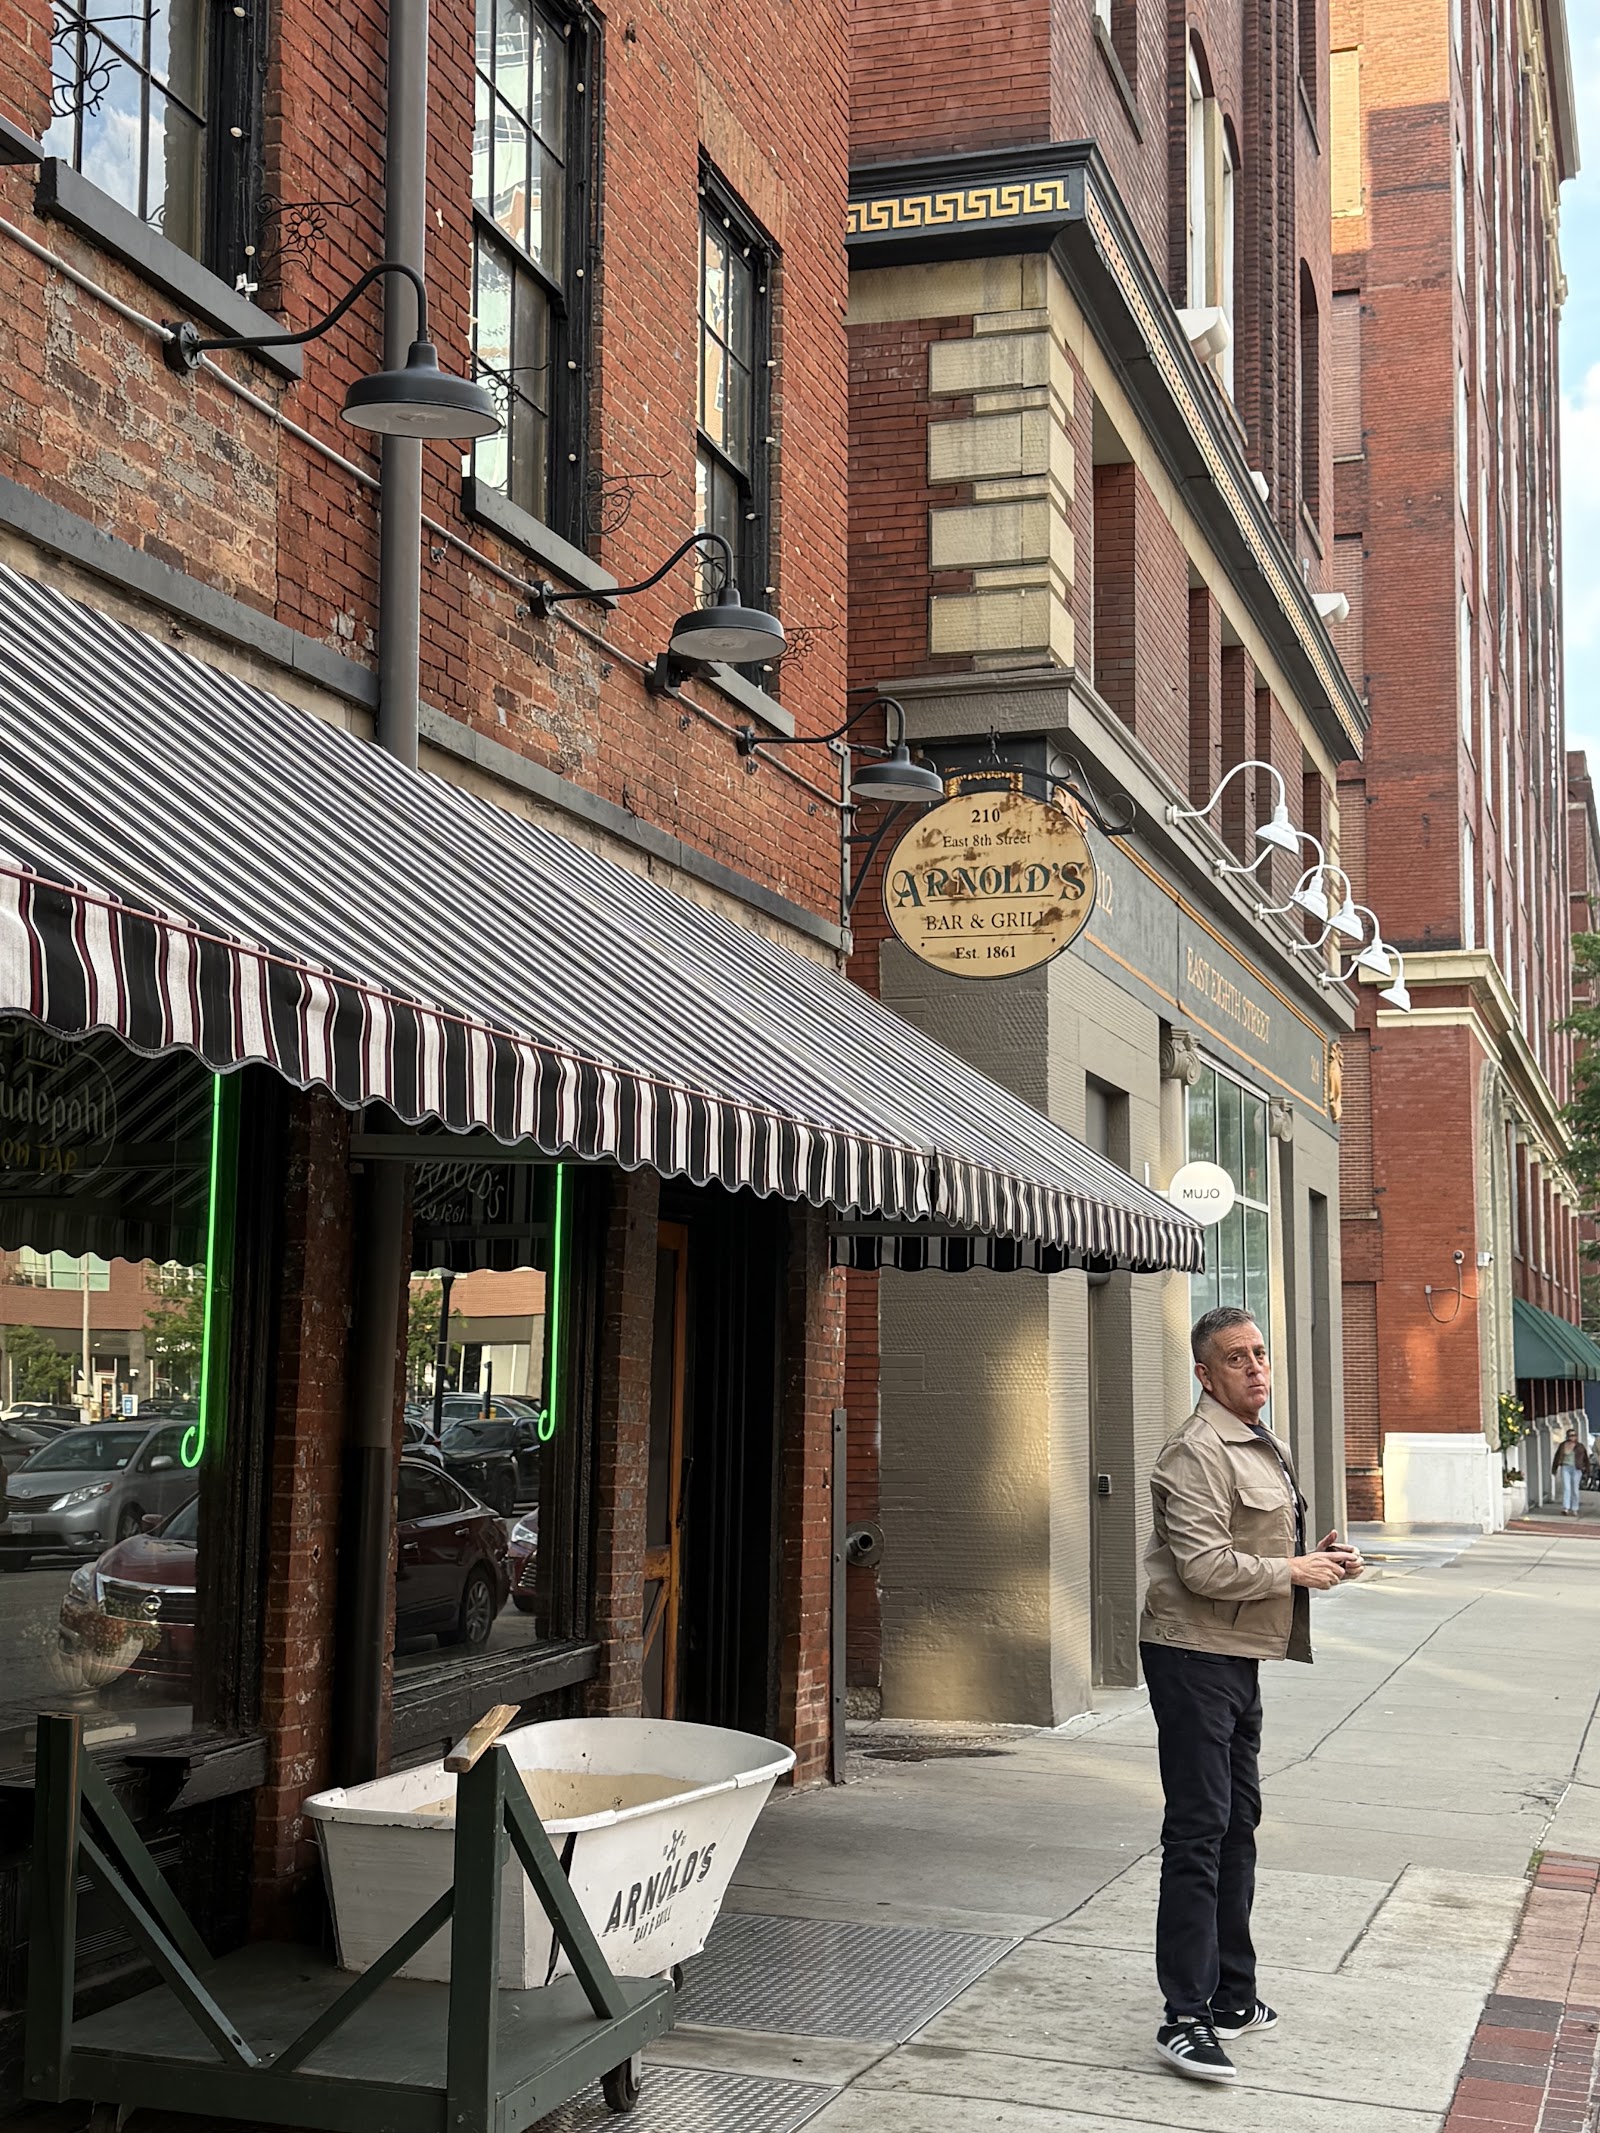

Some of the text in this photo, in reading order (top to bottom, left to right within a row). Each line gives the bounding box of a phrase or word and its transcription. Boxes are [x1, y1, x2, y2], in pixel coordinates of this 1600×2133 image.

[971, 809, 1001, 823] 210
[943, 832, 1031, 848] East 8th Street
[892, 861, 1086, 908] ARNOLD'S
[926, 915, 964, 931] BAR
[970, 913, 984, 929] &
[955, 946, 1016, 960] Est. 1861
[1187, 946, 1209, 996] EAST
[1182, 1188, 1220, 1199] MUJO
[602, 1842, 716, 1937] ARNOLD'S
